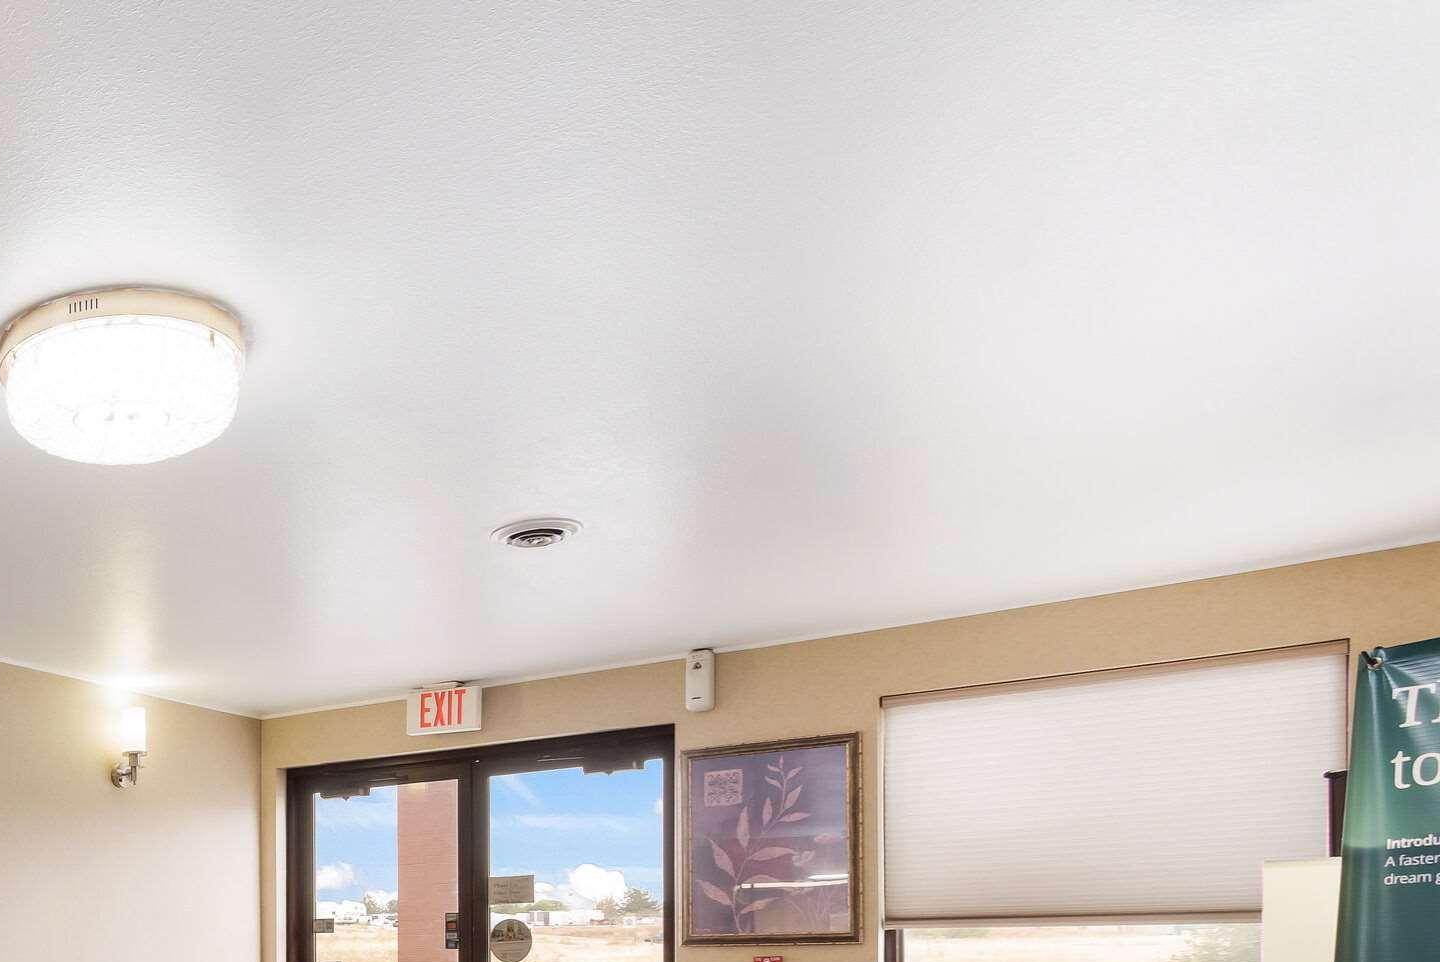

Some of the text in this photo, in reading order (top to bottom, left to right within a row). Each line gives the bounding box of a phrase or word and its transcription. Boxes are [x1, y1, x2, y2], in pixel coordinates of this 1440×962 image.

[420, 689, 466, 728] EXIT
[1390, 750, 1440, 790] to
[1384, 854, 1440, 867] A faster
[1383, 872, 1432, 886] dream
